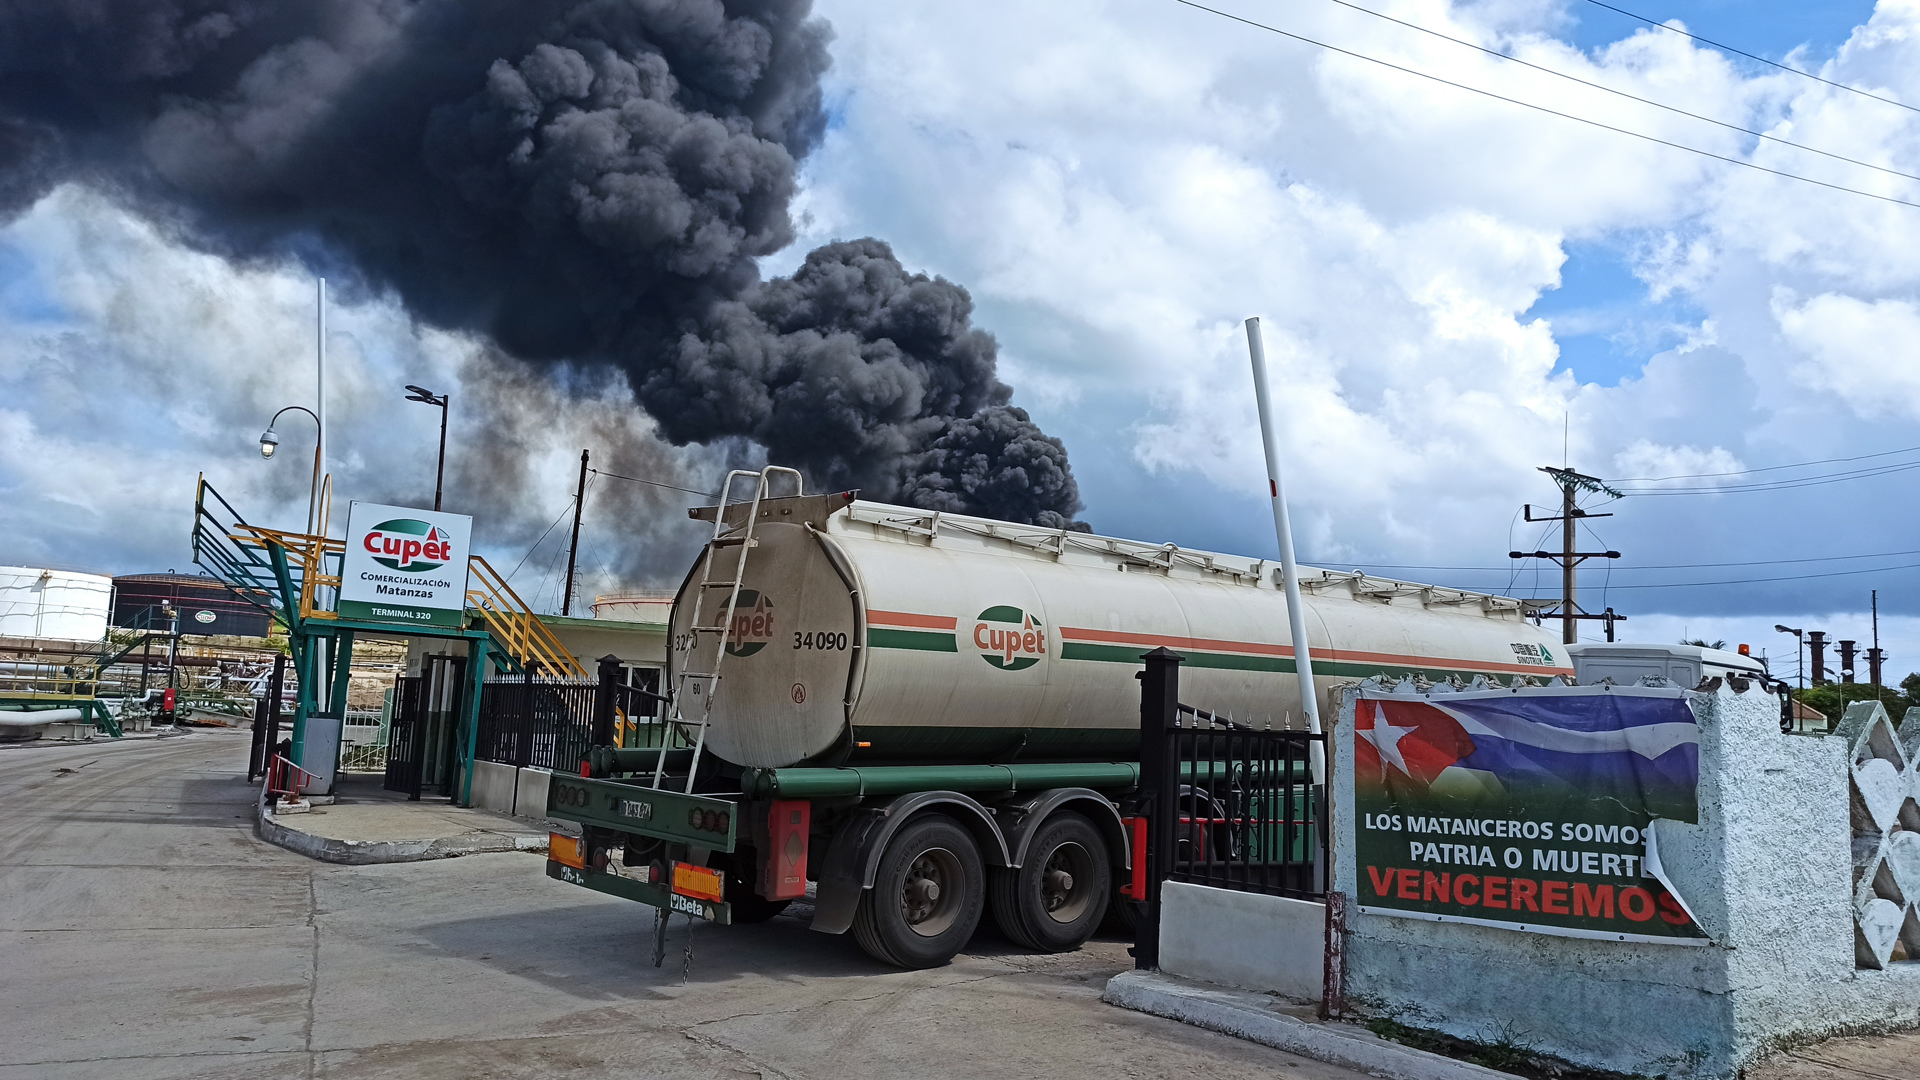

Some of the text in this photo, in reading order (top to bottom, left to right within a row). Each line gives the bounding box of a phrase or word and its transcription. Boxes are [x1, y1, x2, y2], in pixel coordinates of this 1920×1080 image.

[360, 571, 451, 588] COMERCIALIZACIÓN
[376, 584, 433, 599] Matanzas
[371, 607, 431, 620] TERMINAL 320
[692, 683, 700, 695] 60
[1365, 813, 1402, 832] LOS
[1407, 815, 1554, 840] MATANCEROS
[1410, 841, 1497, 868] PATRIA
[1503, 847, 1523, 870] O
[1367, 865, 1691, 925] VENCEREMOS
[679, 895, 703, 916] Beta
